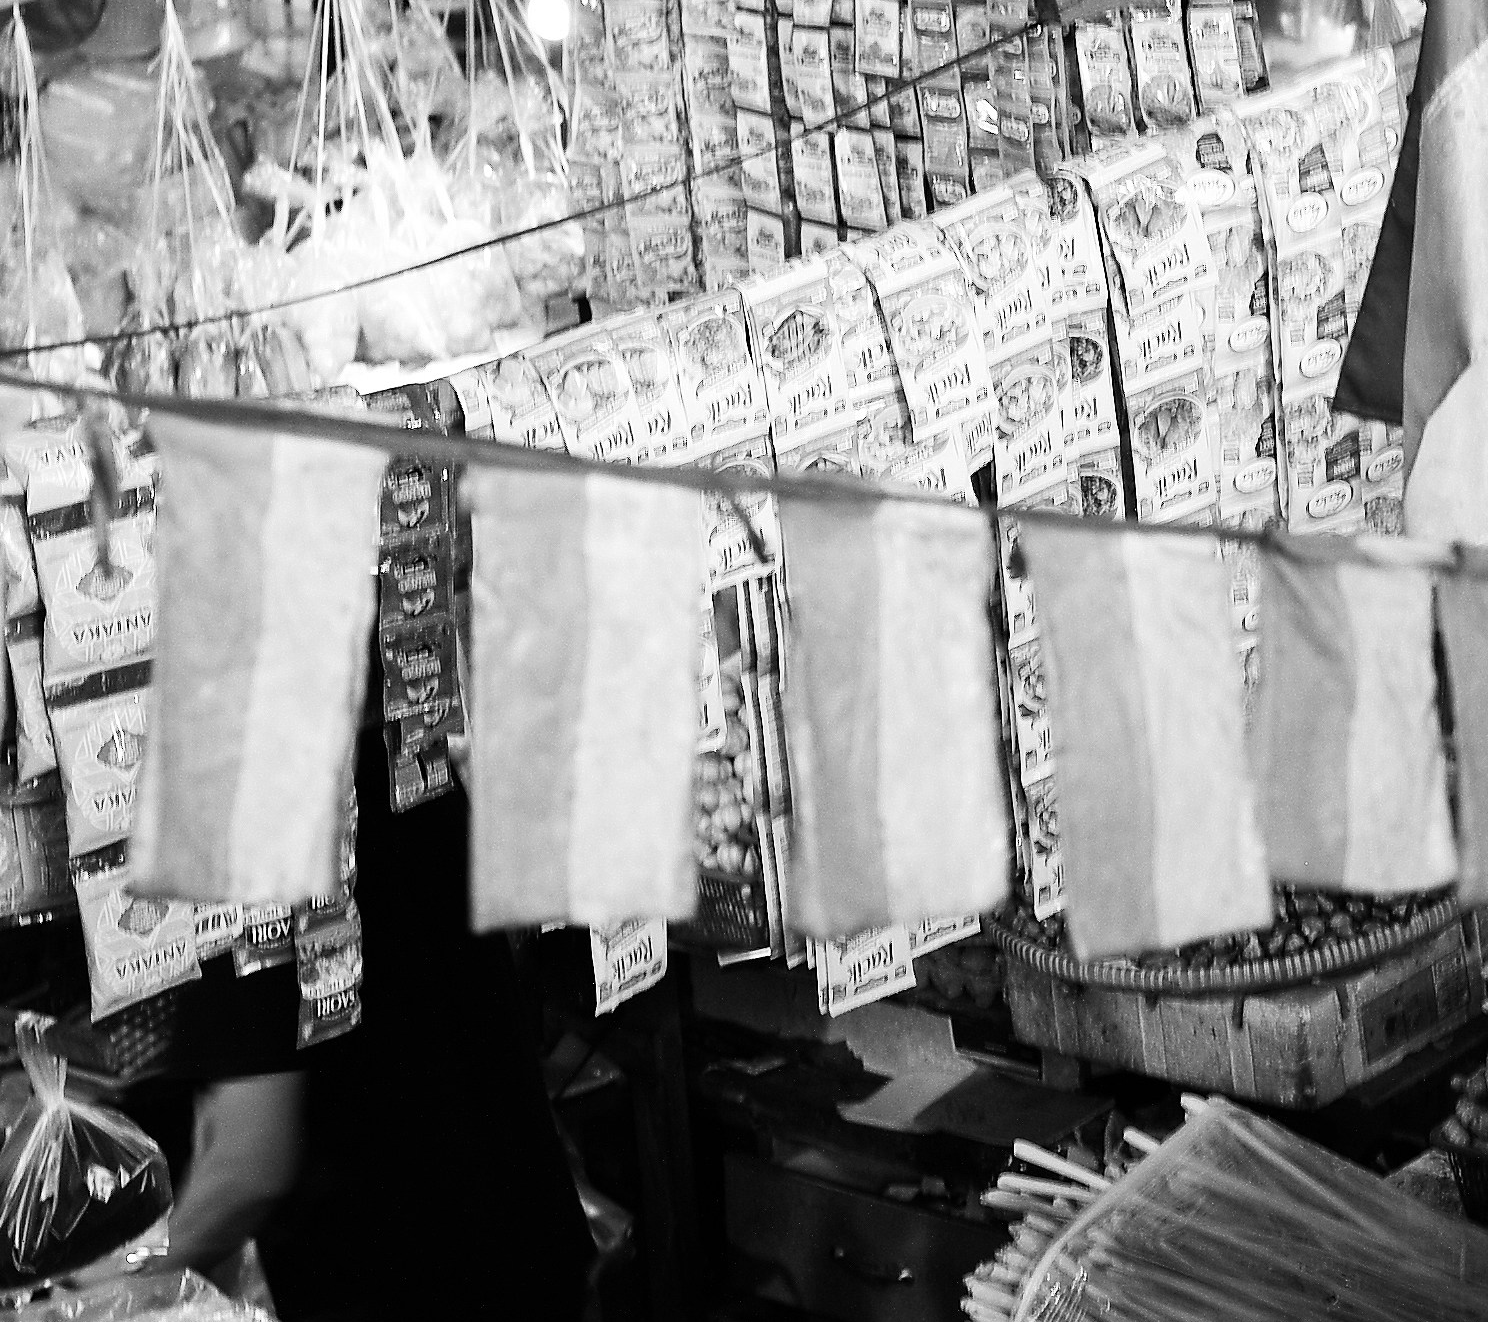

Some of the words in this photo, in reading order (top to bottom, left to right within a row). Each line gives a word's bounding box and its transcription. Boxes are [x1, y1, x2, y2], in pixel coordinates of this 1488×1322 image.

[1145, 238, 1190, 285] Racik
[1141, 318, 1183, 360] Racik
[711, 381, 753, 422] Racik
[789, 375, 832, 415] Racik
[927, 363, 970, 407] Racik
[1155, 458, 1198, 500] Racik
[72, 612, 153, 644] ANTAKA
[116, 940, 188, 979] ANTAKA
[847, 933, 895, 983] Racik
